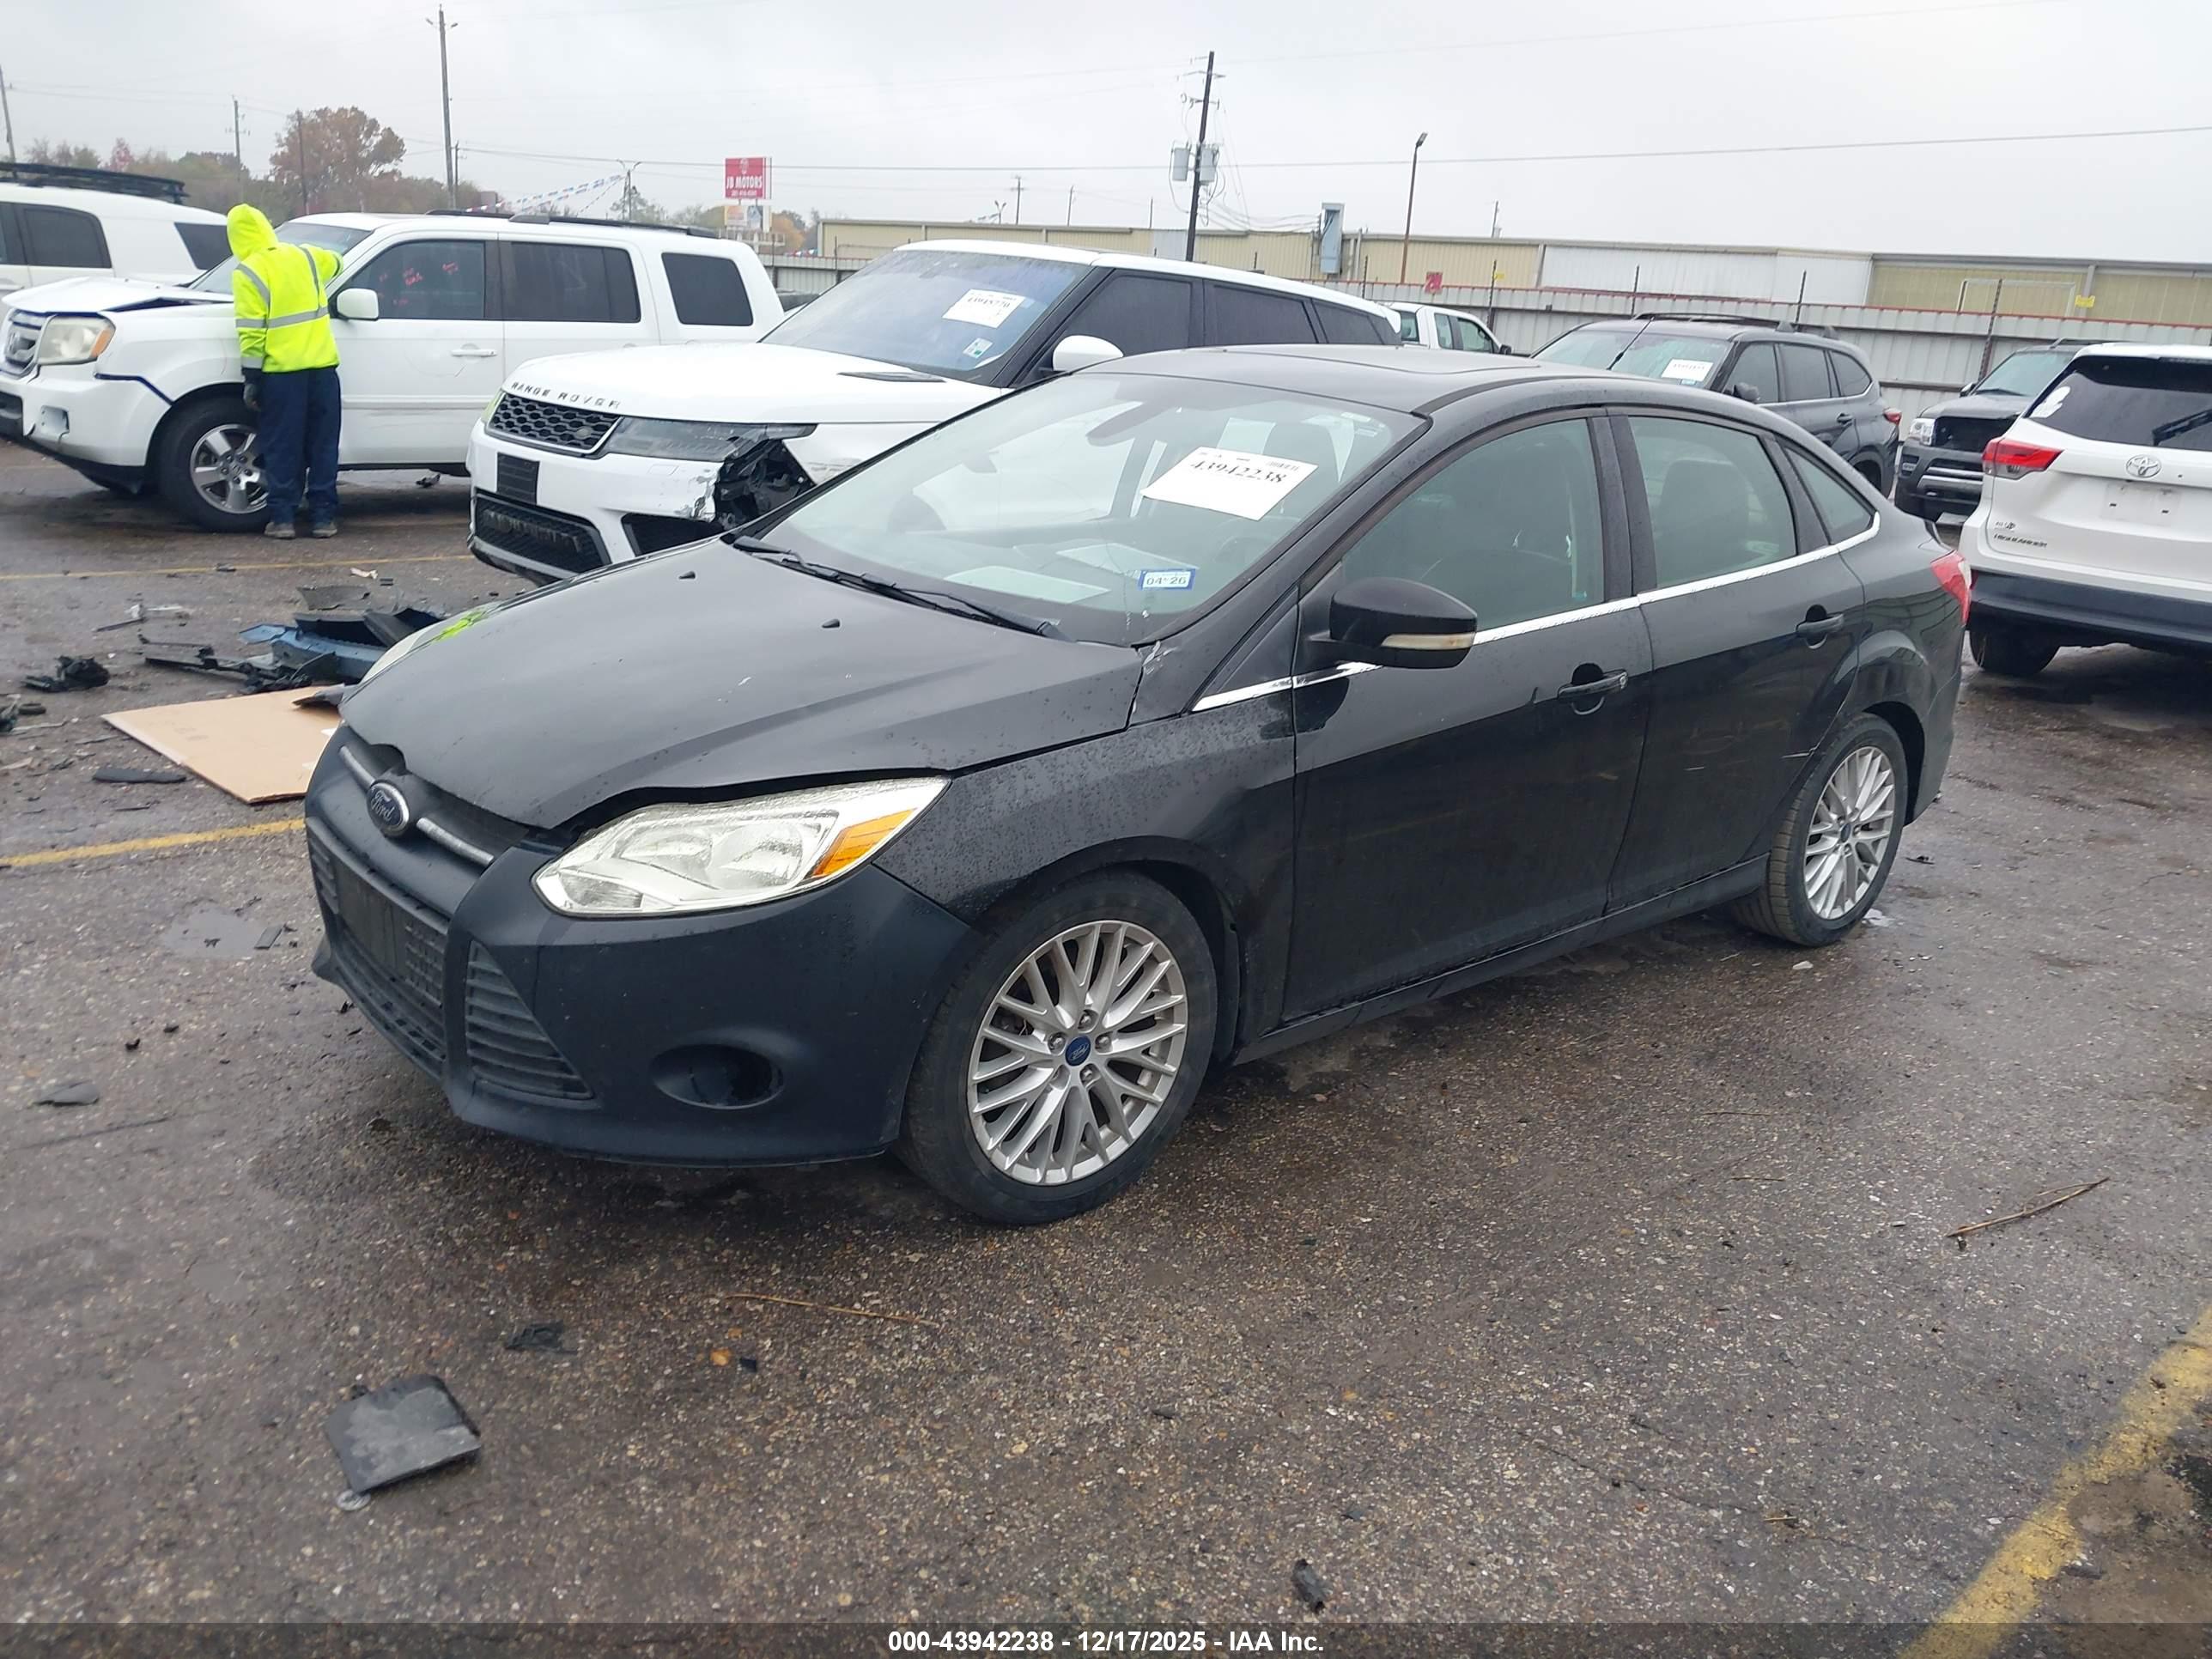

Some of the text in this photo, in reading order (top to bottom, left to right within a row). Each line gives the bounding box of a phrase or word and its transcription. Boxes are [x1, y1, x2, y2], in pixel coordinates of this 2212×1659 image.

[735, 176, 763, 189] MOTORS
[511, 381, 621, 409] RANGE ROVER
[1190, 460, 1287, 483] 43942238
[370, 789, 395, 822] Ford
